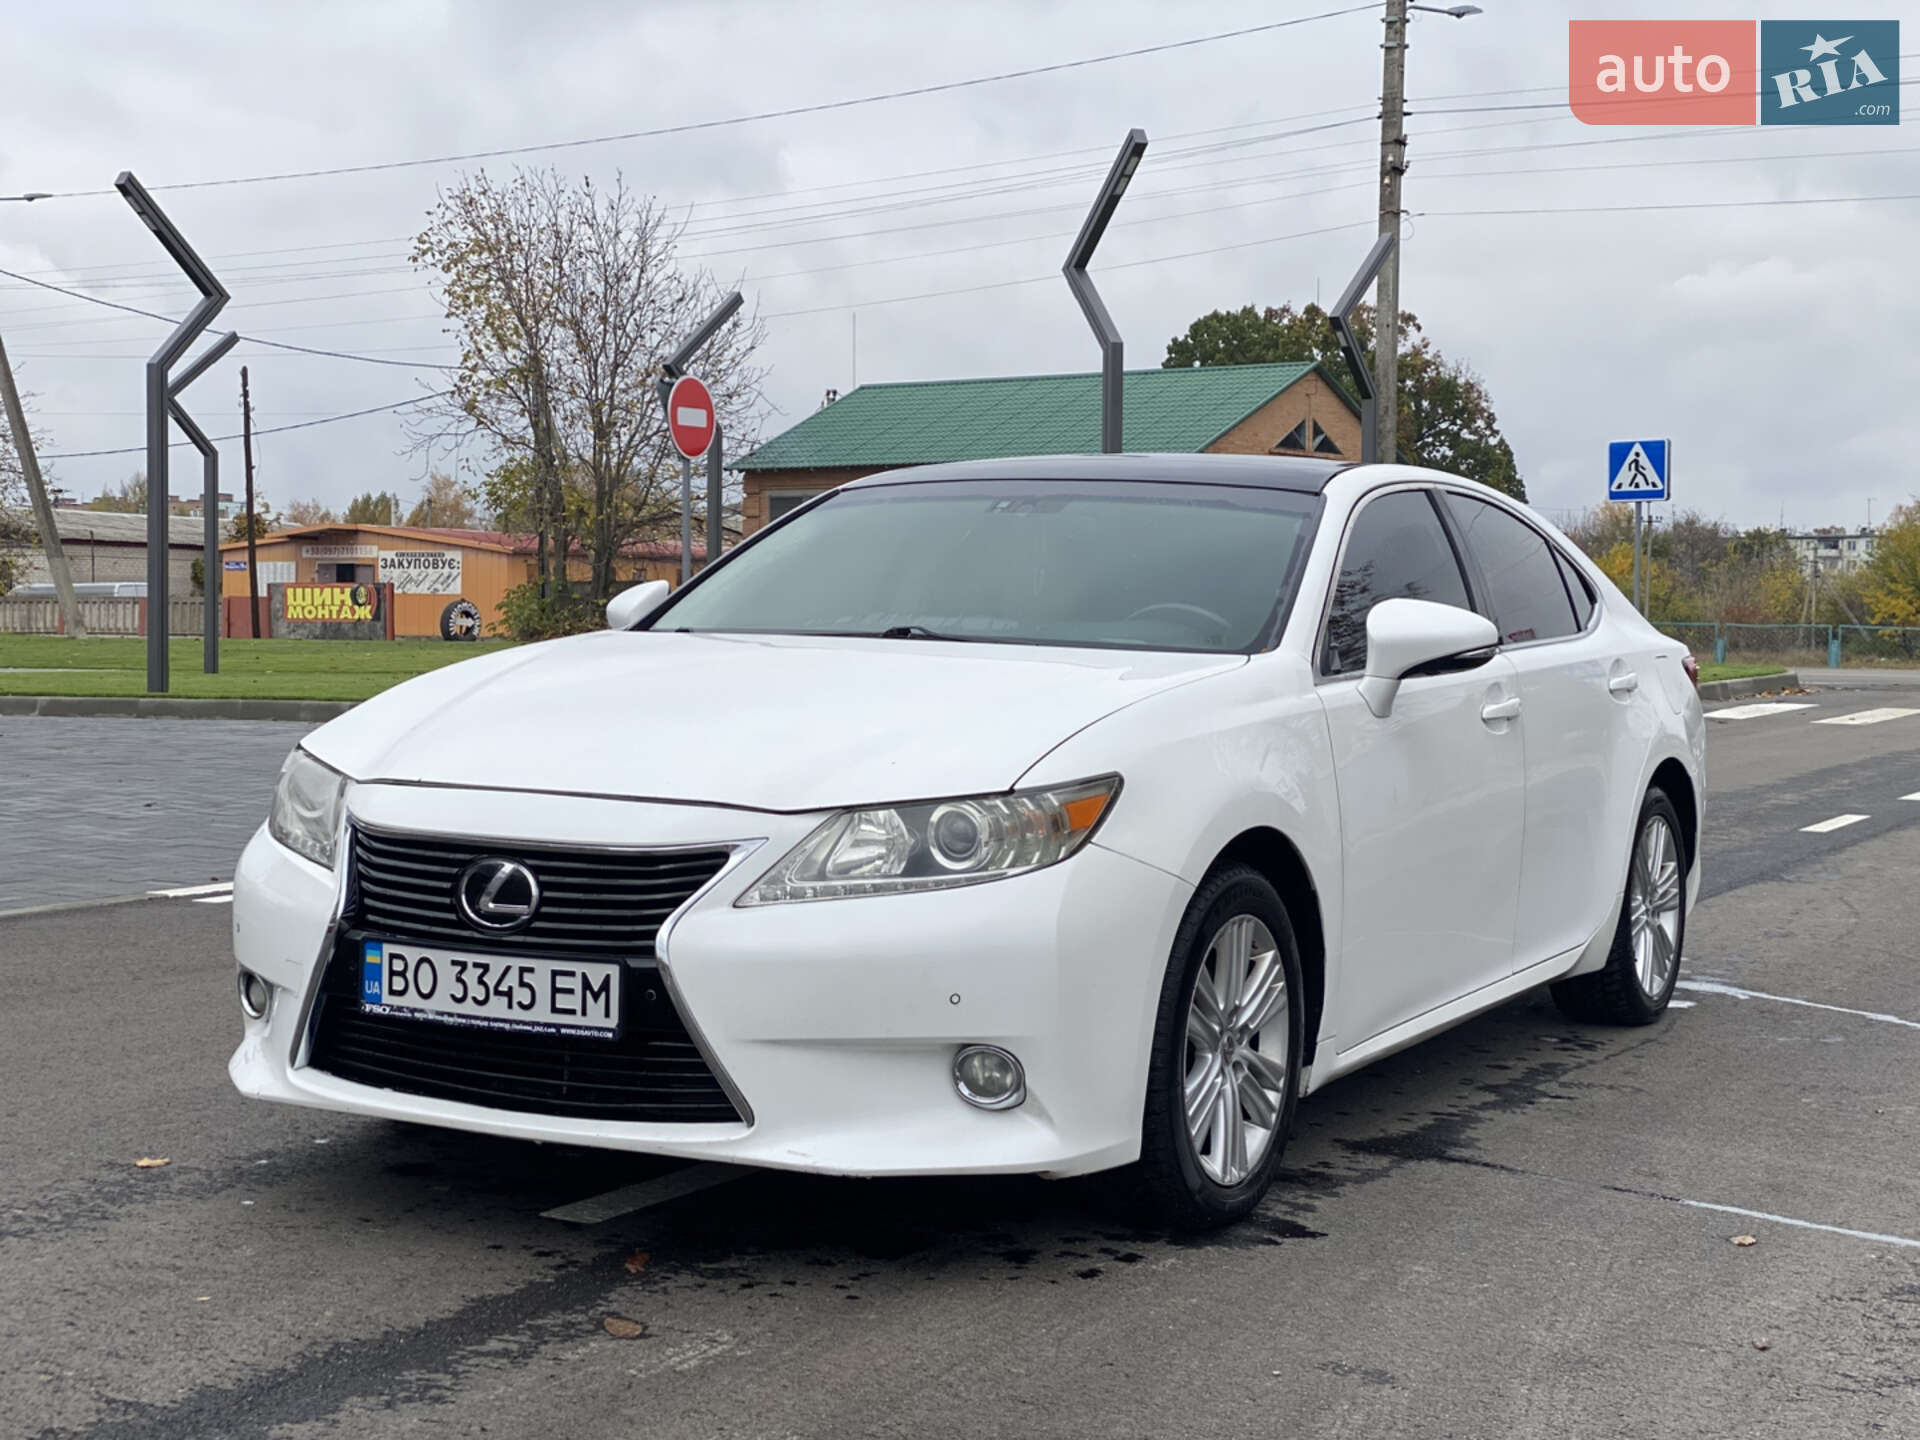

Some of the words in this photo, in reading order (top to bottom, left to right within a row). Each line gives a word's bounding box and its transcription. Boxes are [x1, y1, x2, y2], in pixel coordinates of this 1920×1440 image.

[380, 558, 460, 570] ЗАКУПОВУЄ:
[287, 605, 373, 619] МОНТАЖ
[364, 980, 381, 996] UA
[388, 952, 438, 1000] BO
[450, 959, 537, 1012] 3345
[550, 969, 612, 1019] EM
